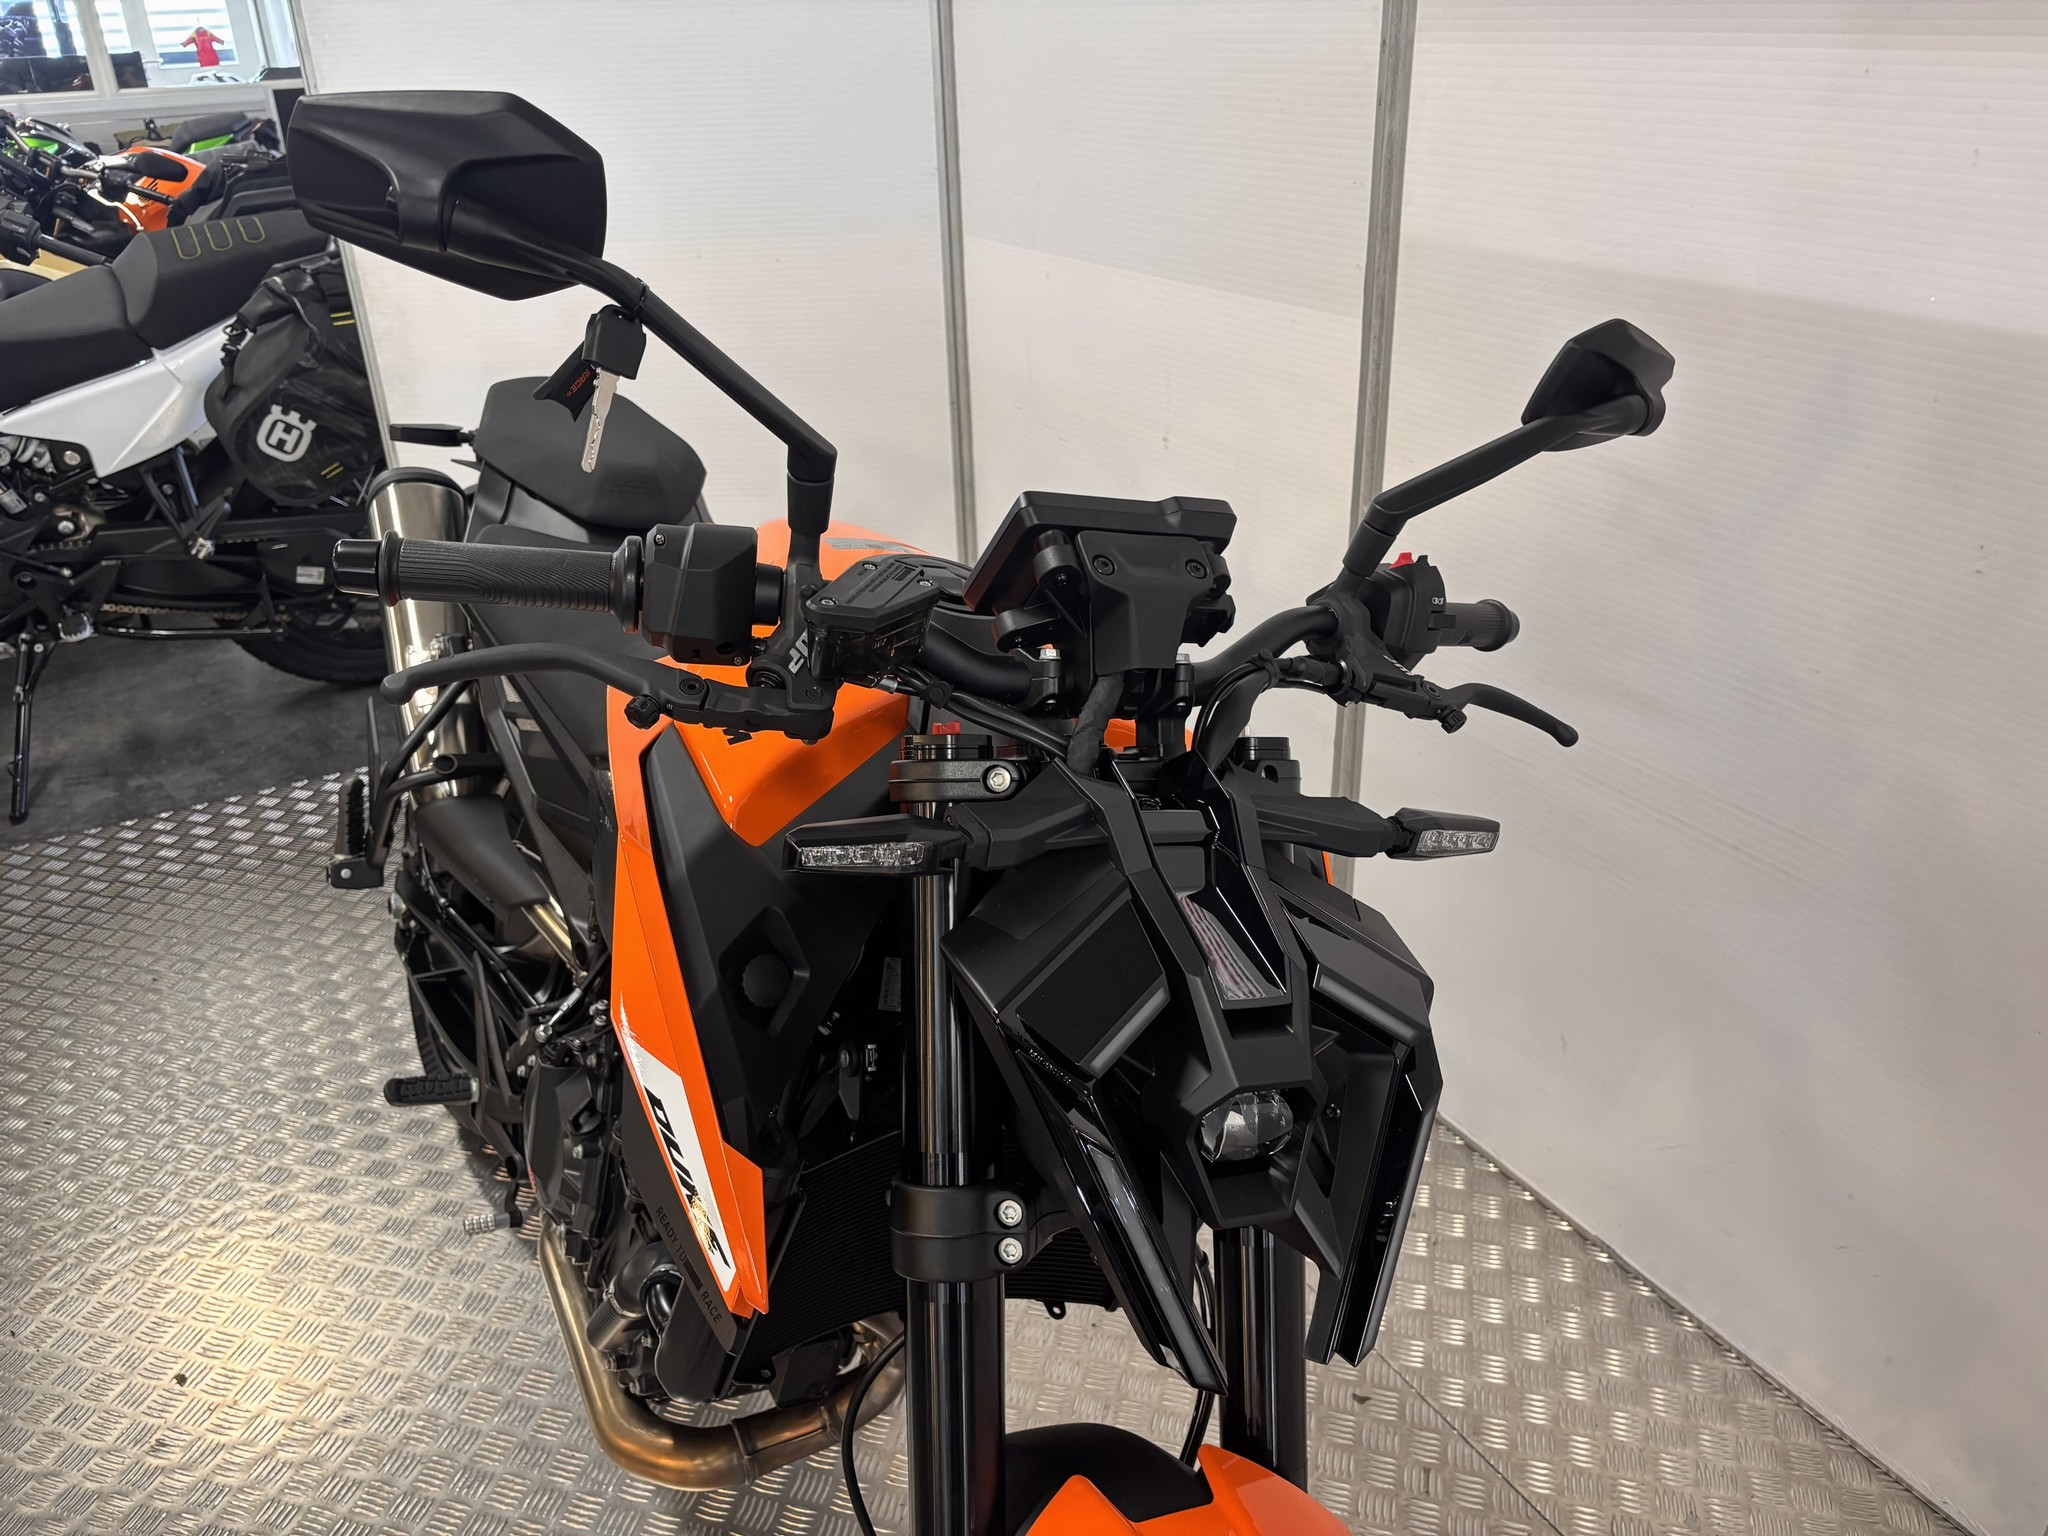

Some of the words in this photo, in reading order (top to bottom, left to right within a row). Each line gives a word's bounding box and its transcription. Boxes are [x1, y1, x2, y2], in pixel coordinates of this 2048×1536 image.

[656, 1207, 679, 1244] READY
[675, 1244, 687, 1264] TO
[701, 1291, 722, 1323] RACE
